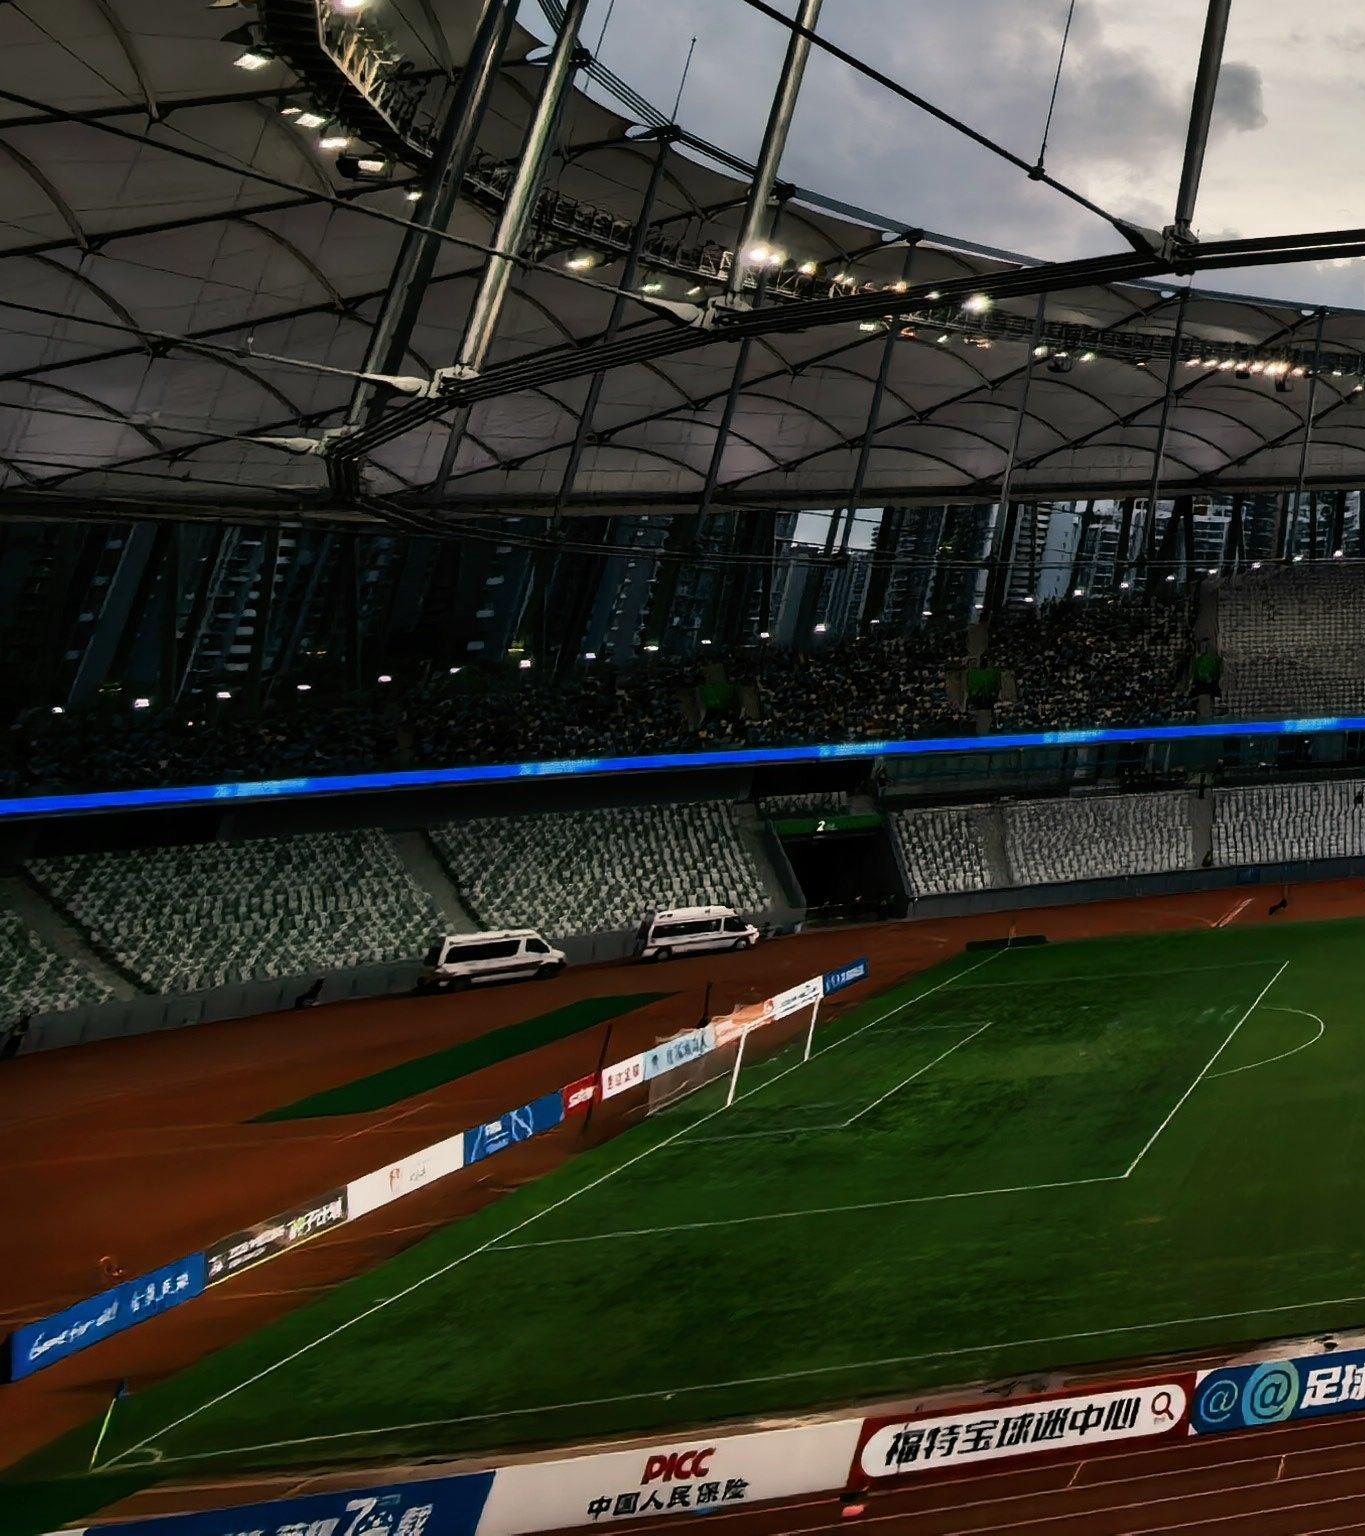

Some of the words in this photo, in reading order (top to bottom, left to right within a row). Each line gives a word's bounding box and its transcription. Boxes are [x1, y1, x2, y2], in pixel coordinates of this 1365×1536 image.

[884, 1397, 1142, 1466] 福特宝球迷中心
[640, 1447, 717, 1485] PICC
[587, 1477, 749, 1520] 中国人民保险
